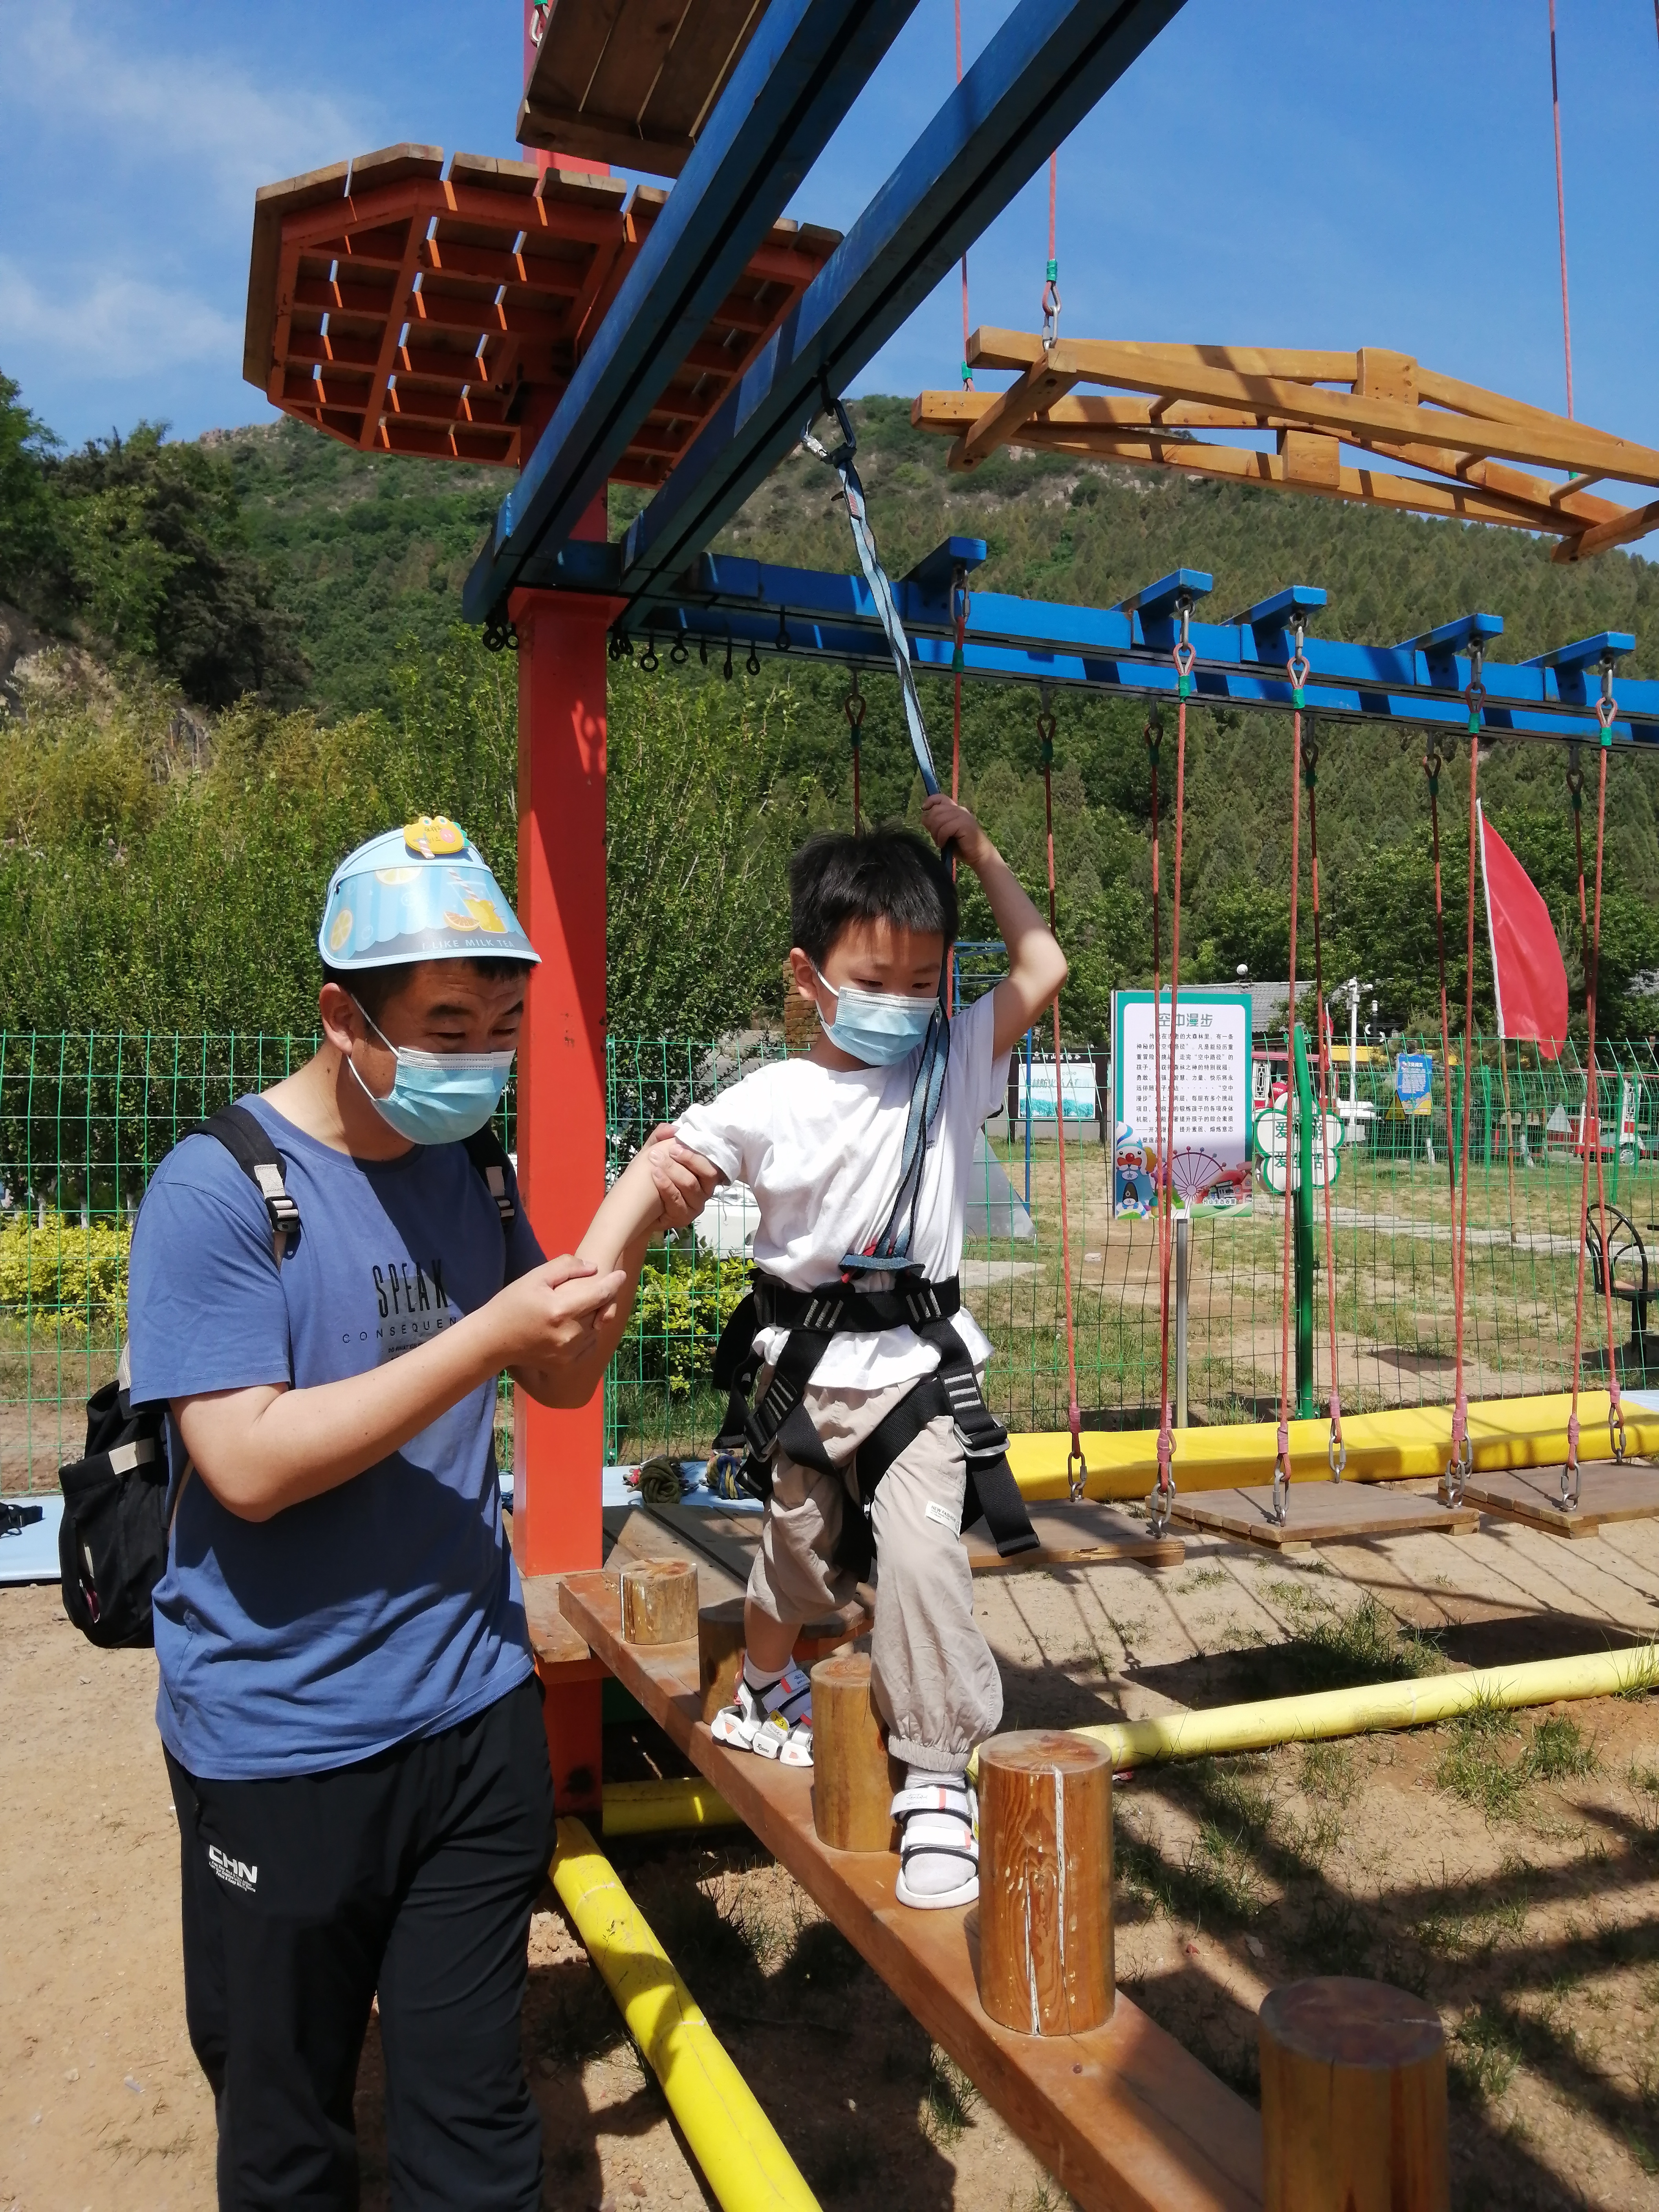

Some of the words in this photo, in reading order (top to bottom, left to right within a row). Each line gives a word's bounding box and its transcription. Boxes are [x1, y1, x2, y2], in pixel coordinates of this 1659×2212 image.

[432, 940, 459, 949] LIKE
[496, 939, 515, 948] TEA
[1158, 1013, 1213, 1027] 空中漫步
[373, 1259, 448, 1318] SPEAK
[209, 1844, 257, 1883] CHN
